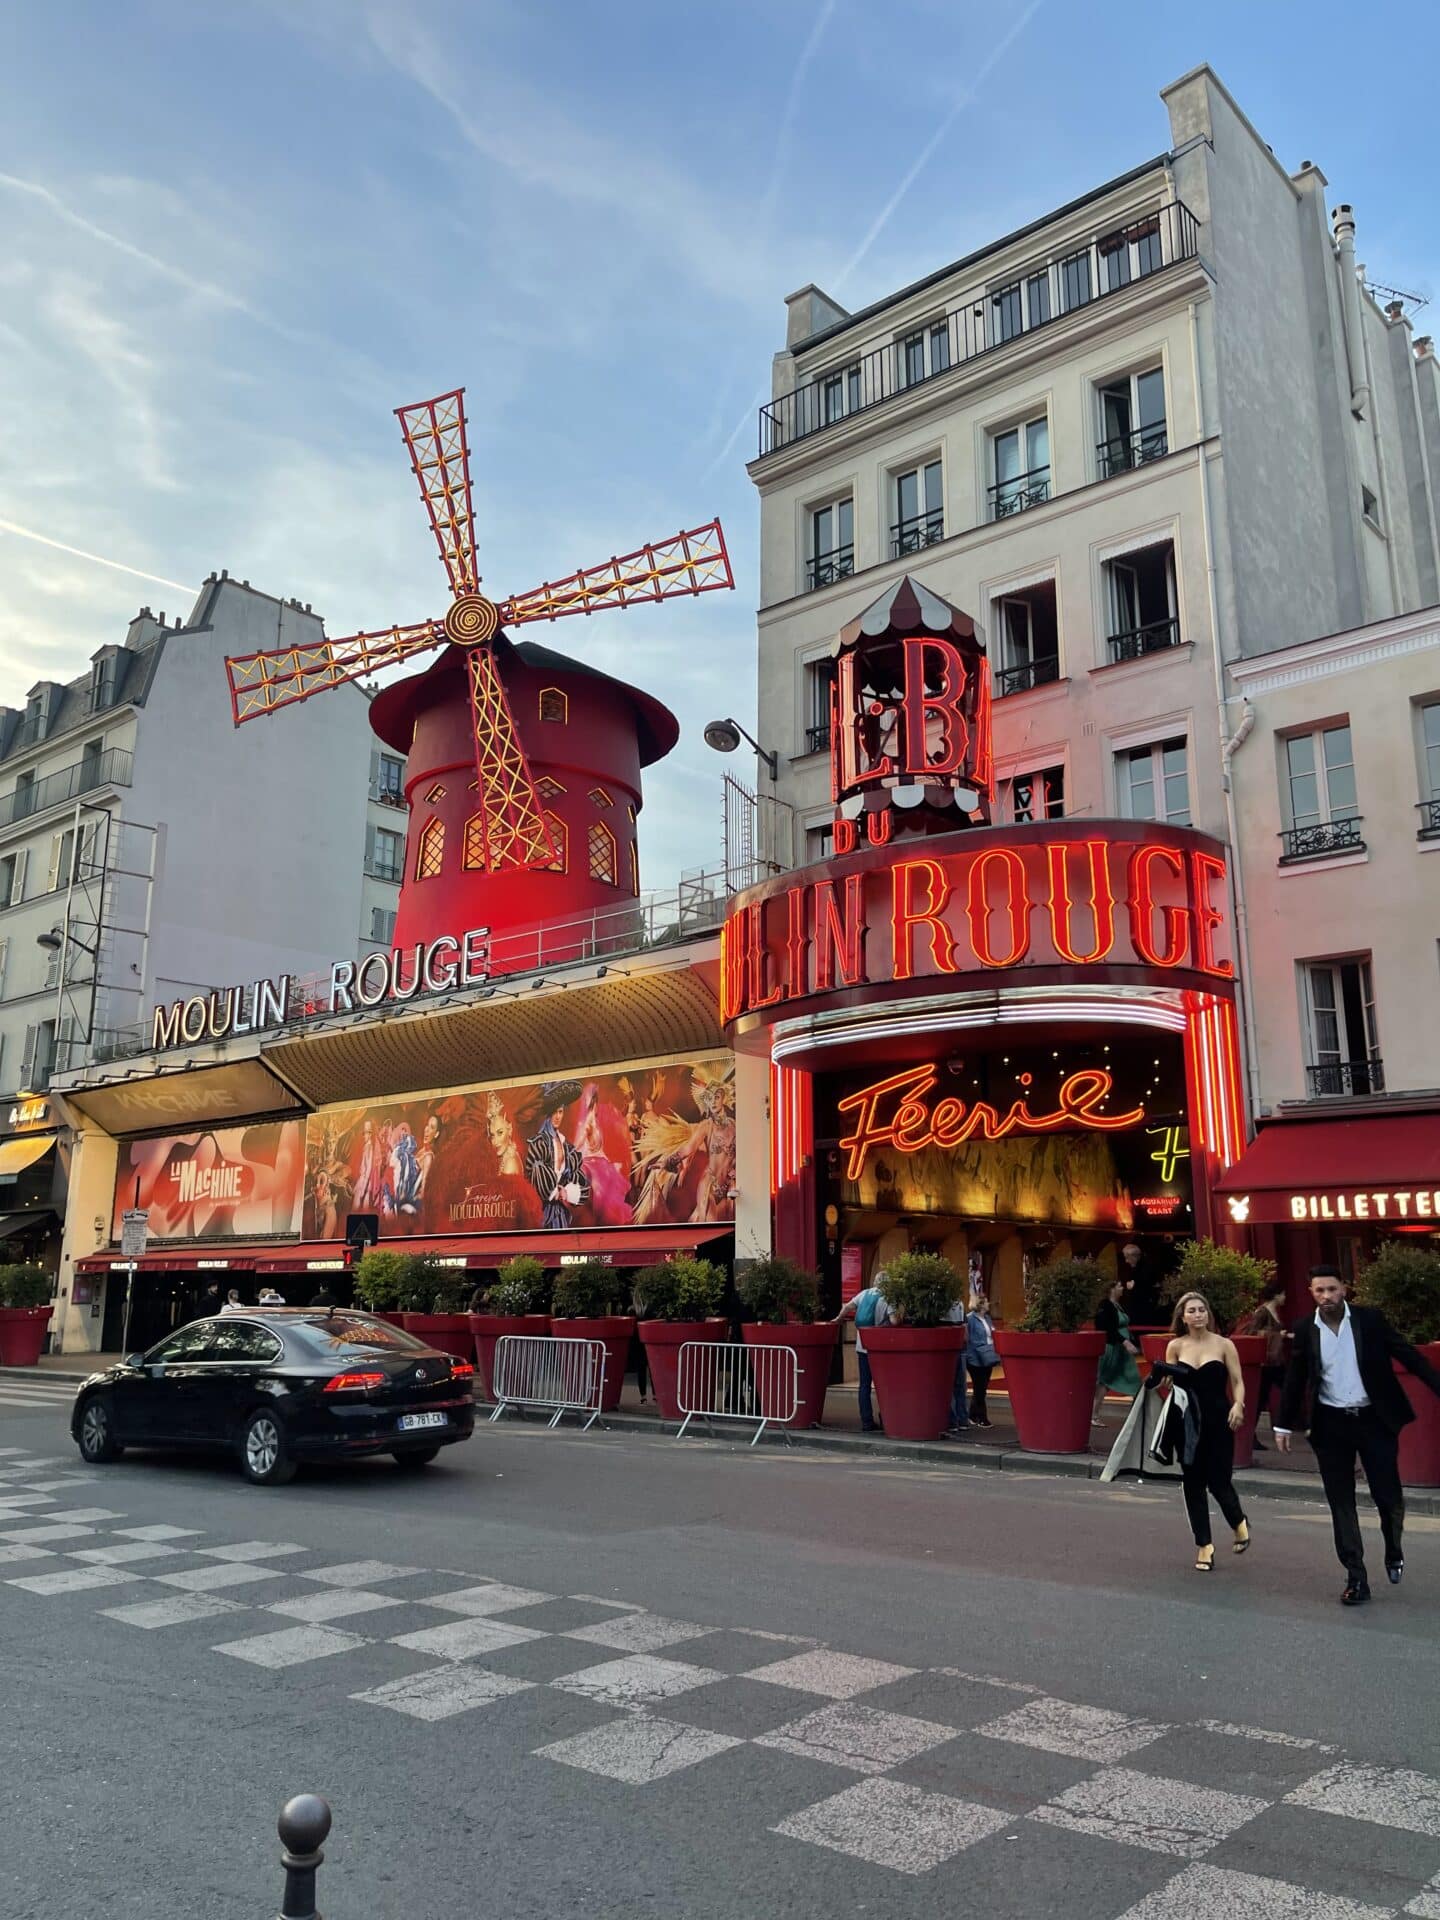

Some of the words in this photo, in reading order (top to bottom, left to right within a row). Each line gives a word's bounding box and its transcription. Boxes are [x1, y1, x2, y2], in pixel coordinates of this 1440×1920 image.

[832, 809, 892, 854] DU
[892, 841, 1234, 979] ROUGE
[152, 974, 291, 1049] MOULIN
[329, 926, 491, 1014] ROUGE
[838, 1063, 1145, 1180] Féerie
[170, 1161, 181, 1179] LA
[179, 1160, 244, 1203] MACHINE
[463, 1183, 505, 1206] Forever
[450, 1202, 483, 1222] MOULIN
[483, 1200, 516, 1218] ROUGE
